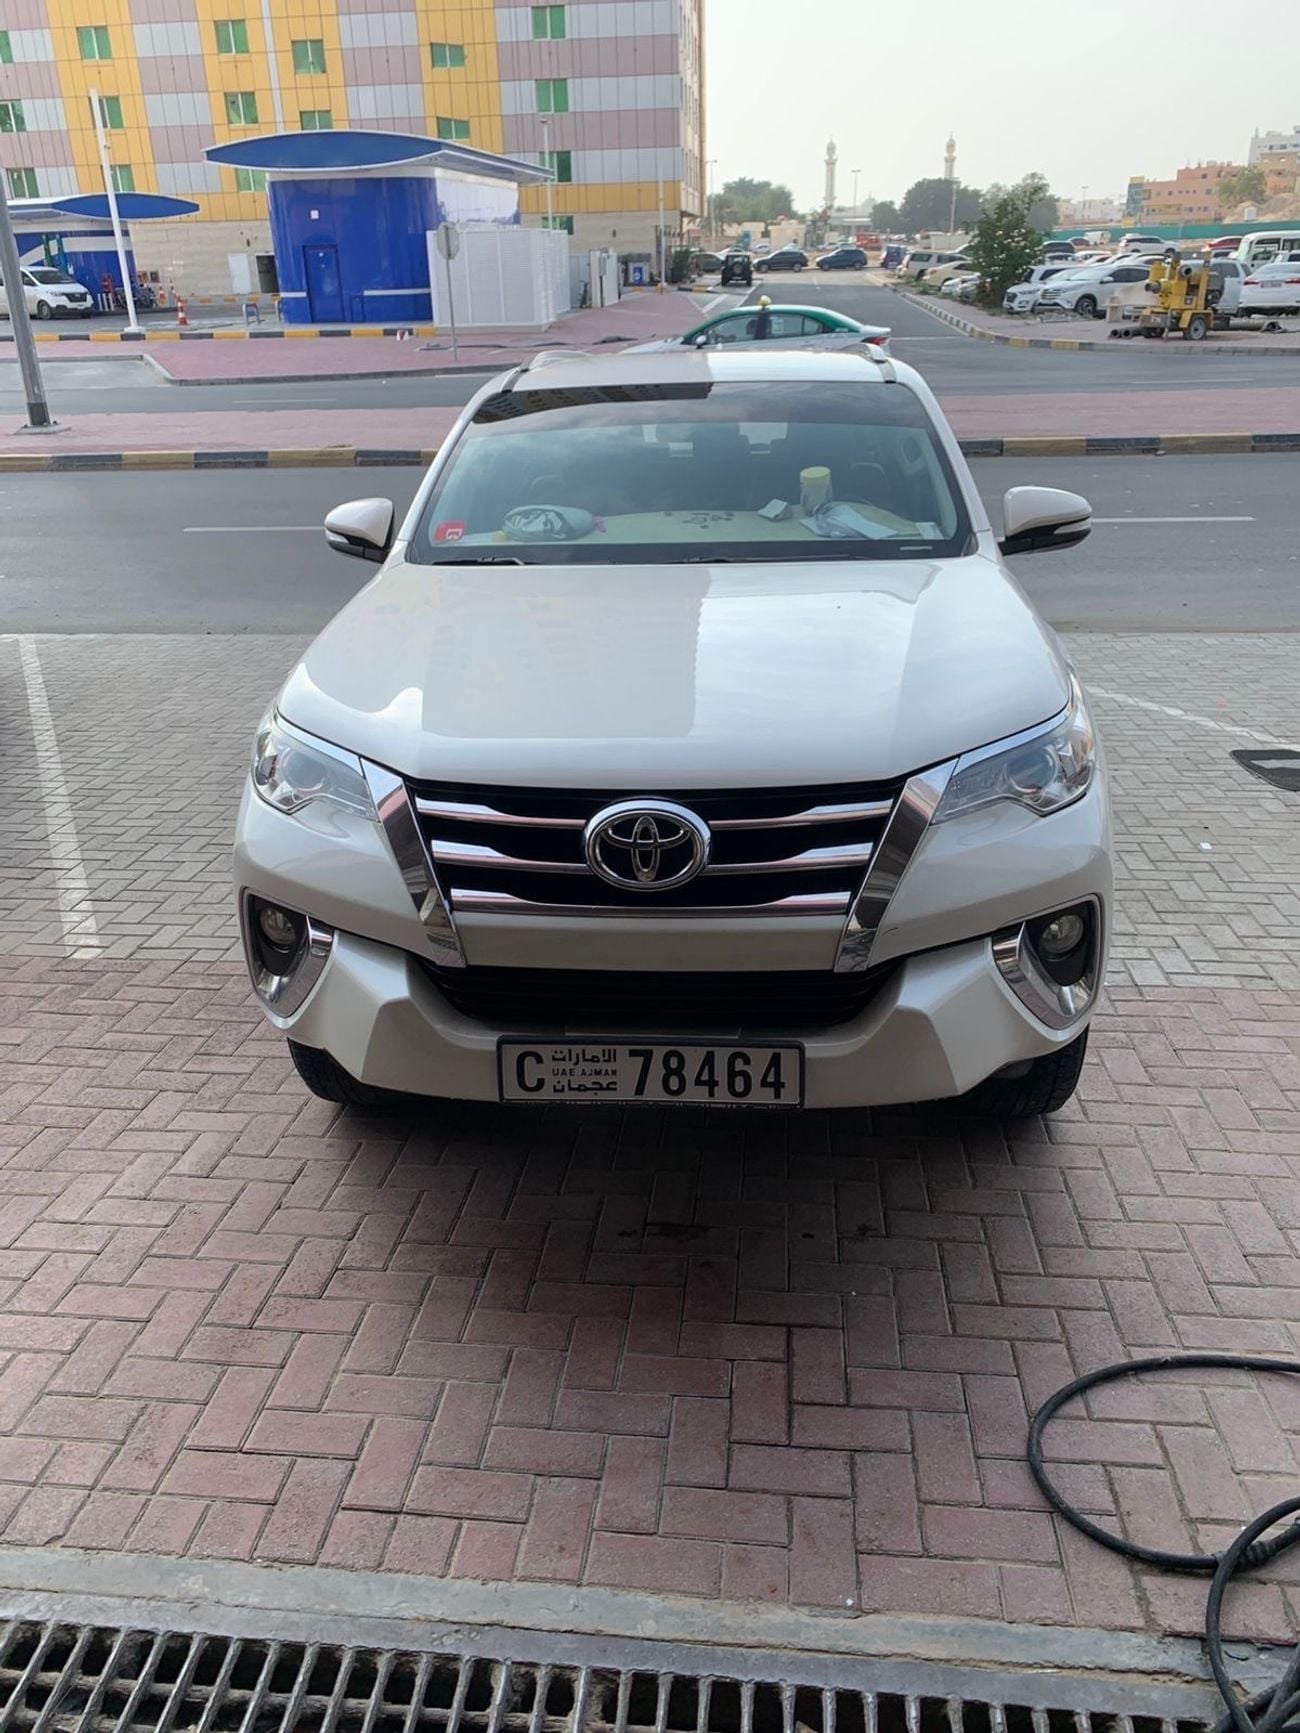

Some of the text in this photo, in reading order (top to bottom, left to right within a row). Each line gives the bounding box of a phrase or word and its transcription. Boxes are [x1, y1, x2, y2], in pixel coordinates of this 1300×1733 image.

[552, 1048, 617, 1066] الامارات
[516, 1051, 545, 1092] C
[552, 1067, 617, 1077] UAE AJMAN
[628, 1049, 786, 1099] 78464
[553, 1079, 618, 1096] عجمان
